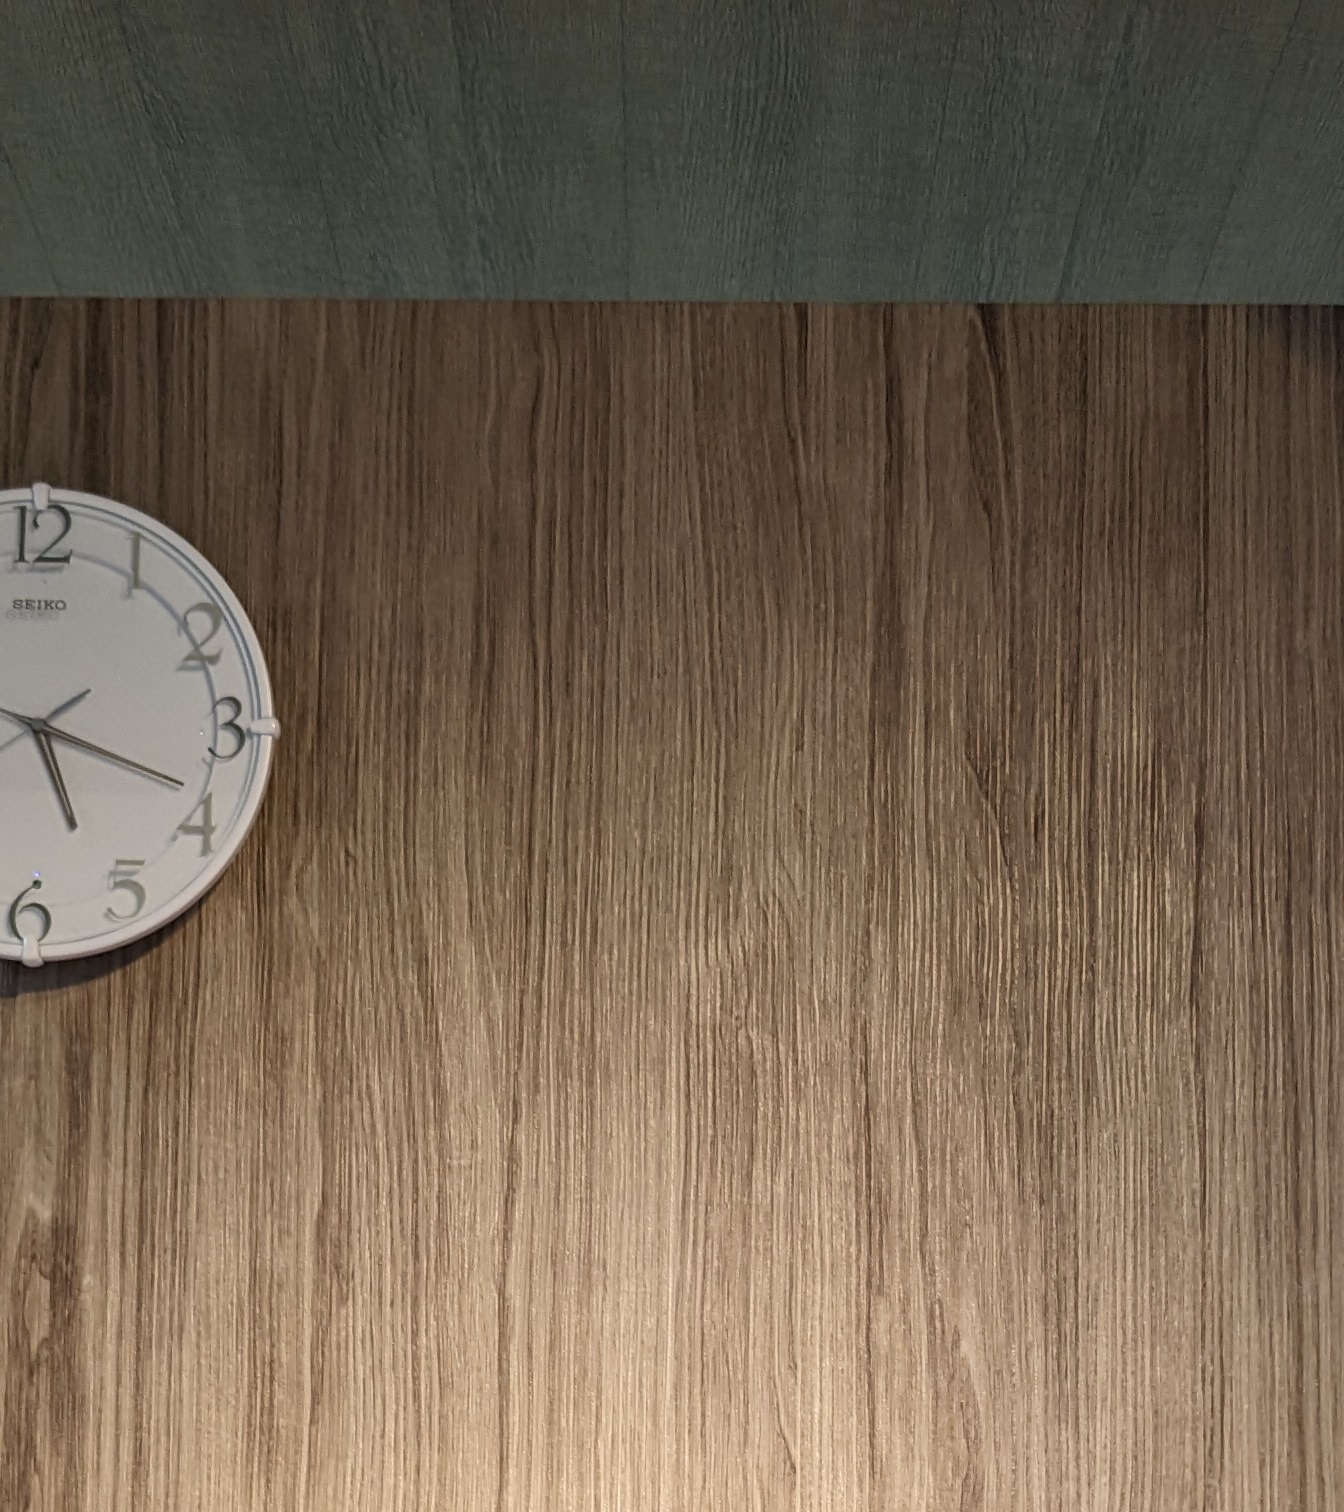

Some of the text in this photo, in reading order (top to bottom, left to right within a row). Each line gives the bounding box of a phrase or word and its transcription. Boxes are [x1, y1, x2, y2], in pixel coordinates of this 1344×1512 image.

[13, 503, 72, 565] 12
[130, 530, 143, 590] 1
[12, 599, 67, 611] SEIKO
[183, 602, 222, 666] 2
[207, 696, 245, 760] 3
[177, 793, 216, 857] 4
[8, 879, 52, 942] 6
[106, 859, 146, 920] 5
